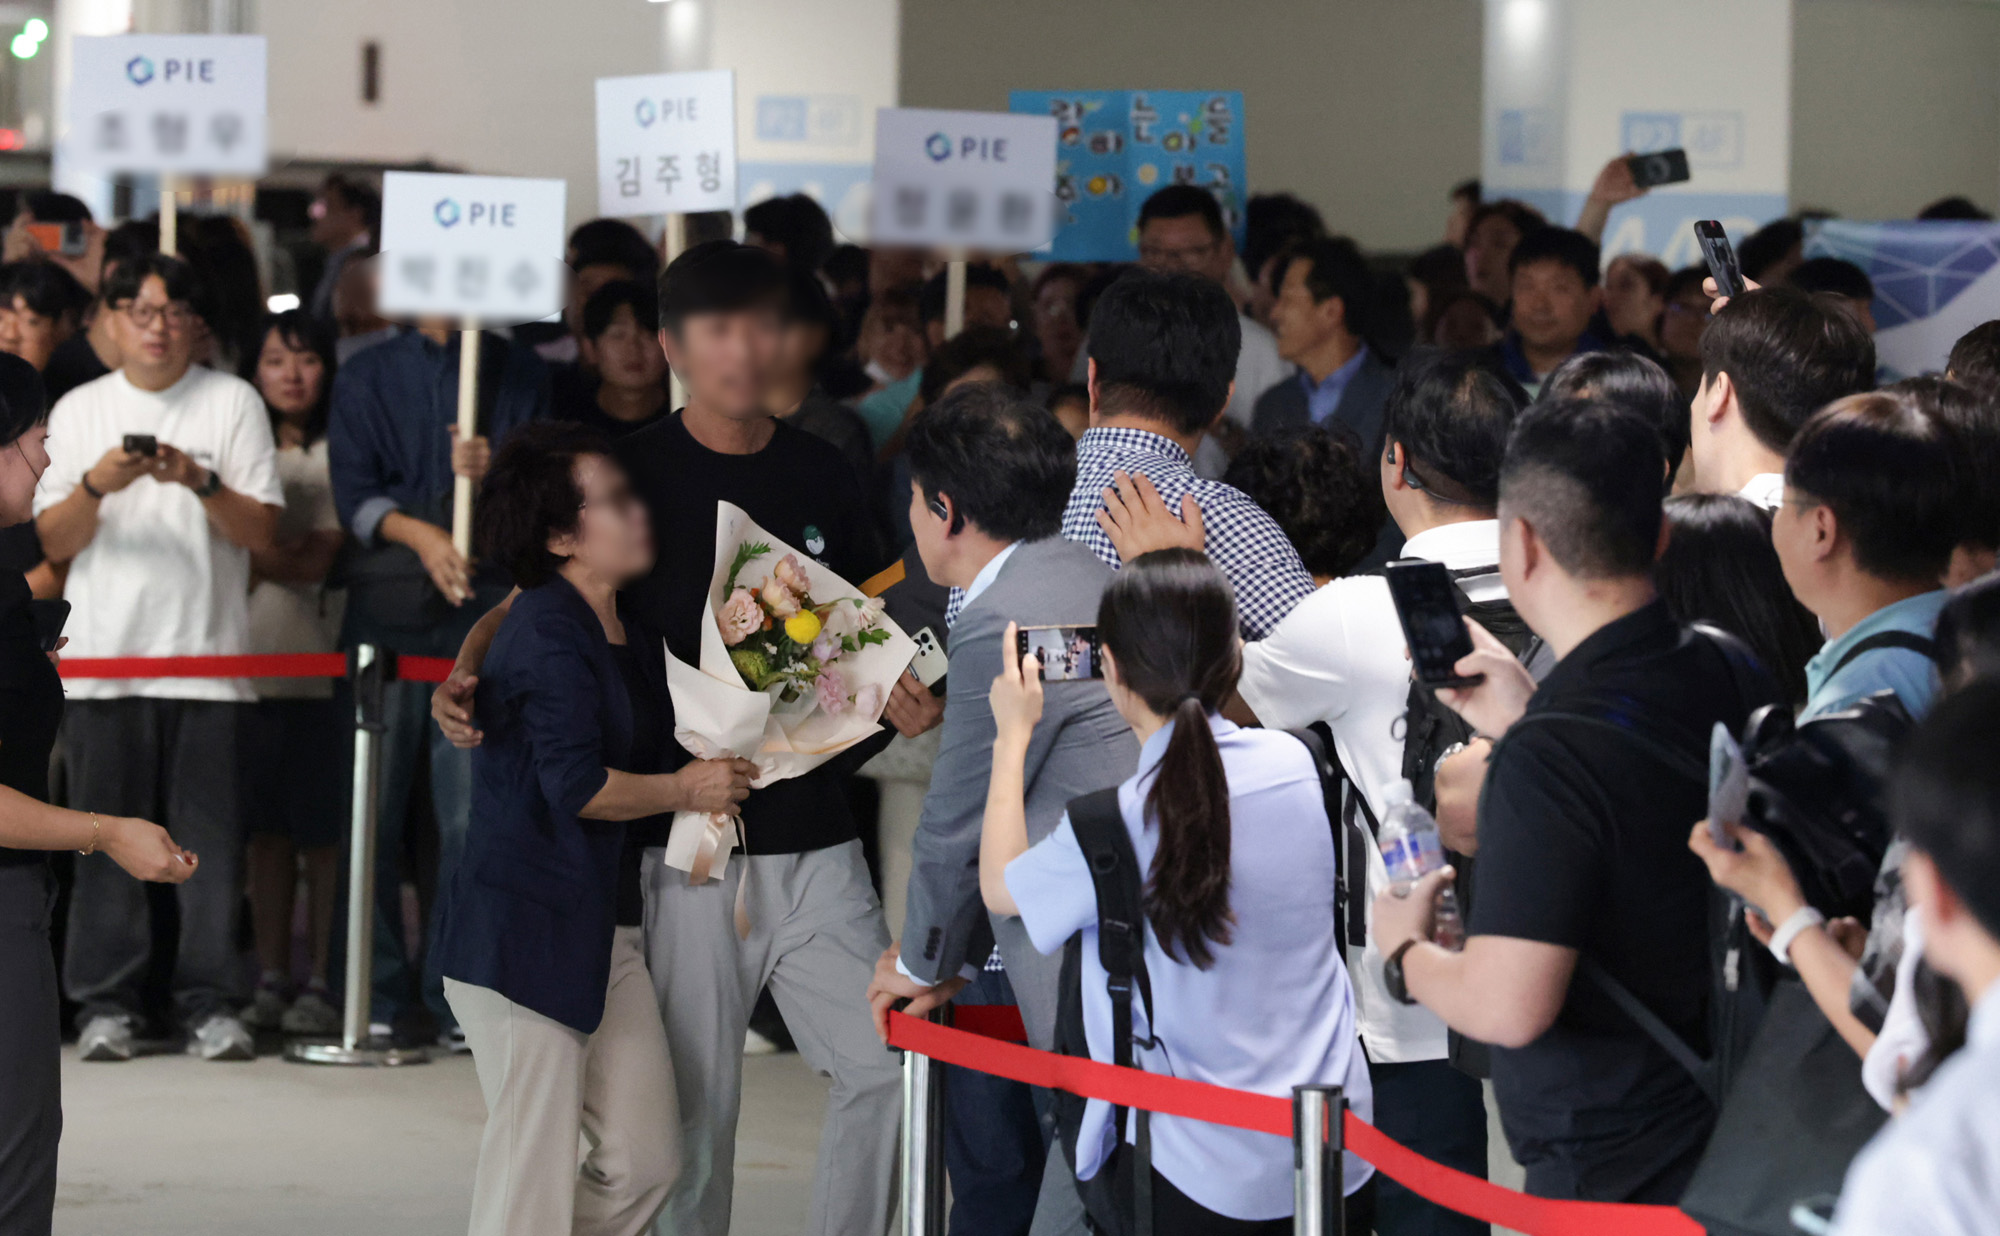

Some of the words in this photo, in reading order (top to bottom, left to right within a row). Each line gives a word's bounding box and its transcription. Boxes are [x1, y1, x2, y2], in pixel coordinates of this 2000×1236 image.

[164, 59, 215, 83] PIE
[661, 97, 698, 122] PIE
[960, 136, 1009, 163] PIE
[616, 151, 721, 198] 김주형
[469, 202, 516, 228] PIE
